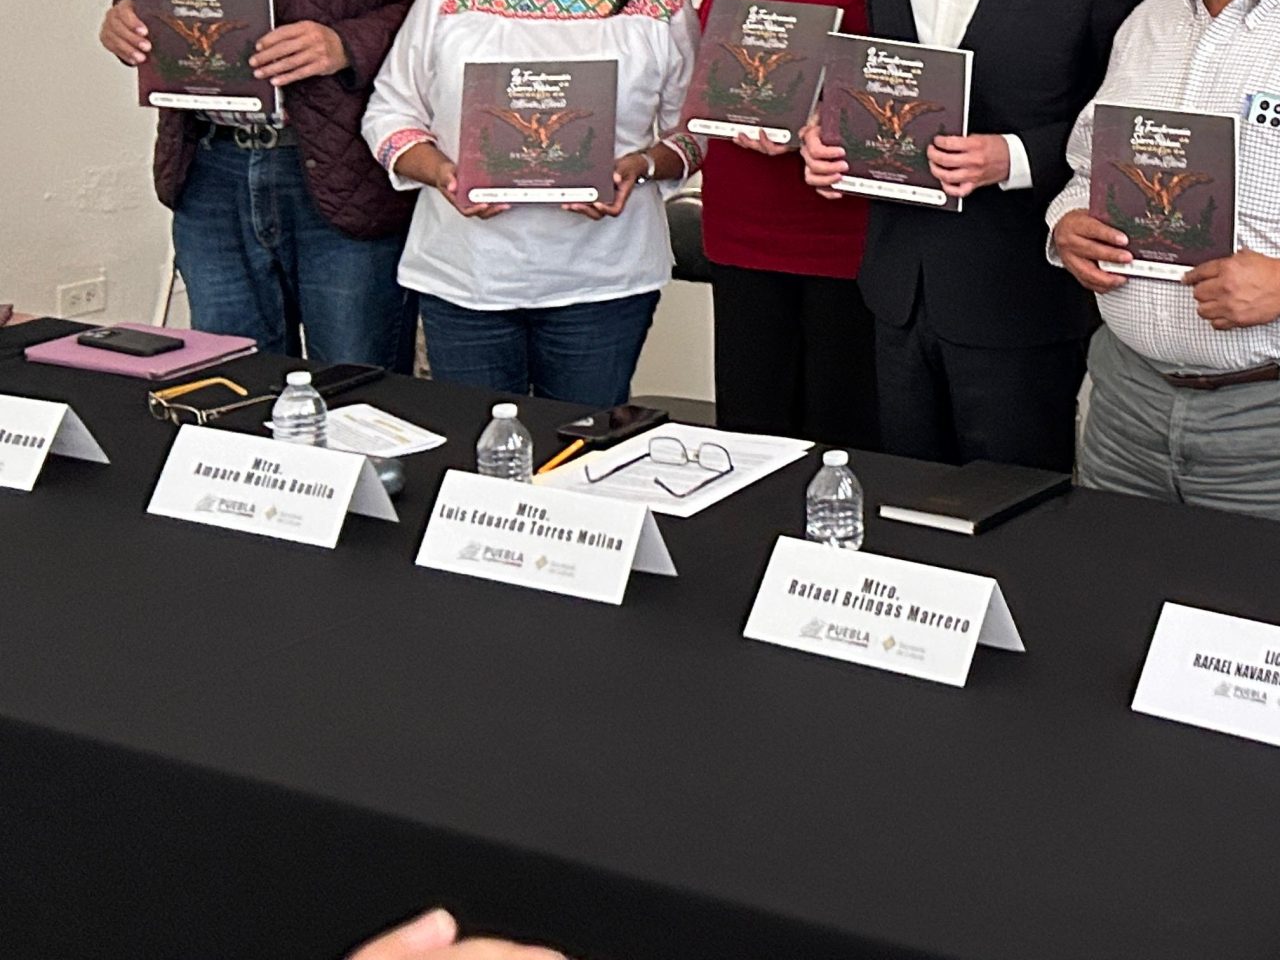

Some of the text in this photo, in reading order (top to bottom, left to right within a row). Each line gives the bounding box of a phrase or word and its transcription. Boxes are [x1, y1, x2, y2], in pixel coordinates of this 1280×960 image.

[194, 462, 335, 499] Amparo Molina Bonilla
[218, 498, 256, 513] PUEBLA
[516, 503, 550, 521] Mtro.
[440, 504, 624, 551] Luis Eduardo Torres Molina
[482, 545, 524, 563] PUEBLA
[861, 578, 900, 600] Mtro.
[787, 579, 971, 634] Rafael Bringas Marrero
[827, 623, 870, 642] PUEBLA
[1193, 653, 1233, 675] RAFAEL
